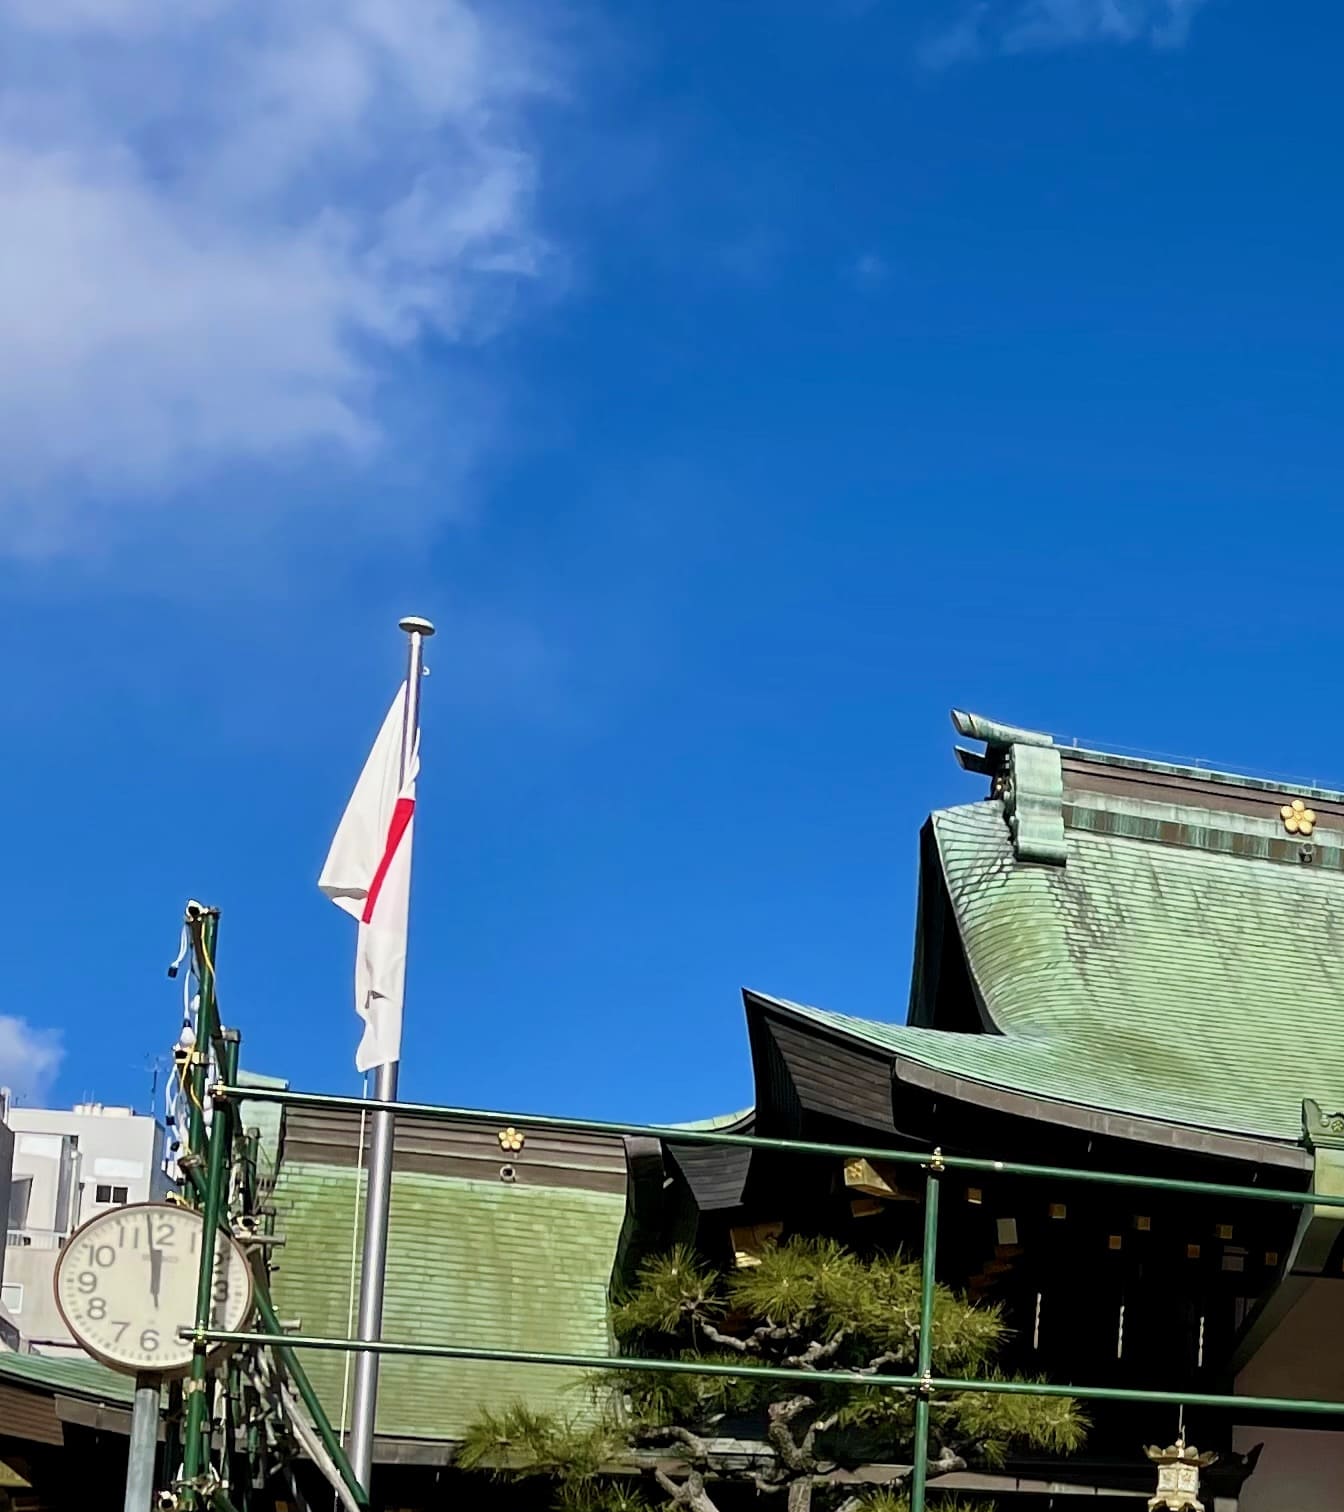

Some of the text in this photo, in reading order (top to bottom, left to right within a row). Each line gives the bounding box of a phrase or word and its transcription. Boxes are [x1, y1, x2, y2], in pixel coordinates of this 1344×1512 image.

[119, 1226, 139, 1249] 11
[89, 1245, 115, 1267] 10
[78, 1271, 98, 1294] 9
[87, 1297, 107, 1320] 8
[111, 1321, 131, 1343] 7
[139, 1329, 160, 1352] 6
